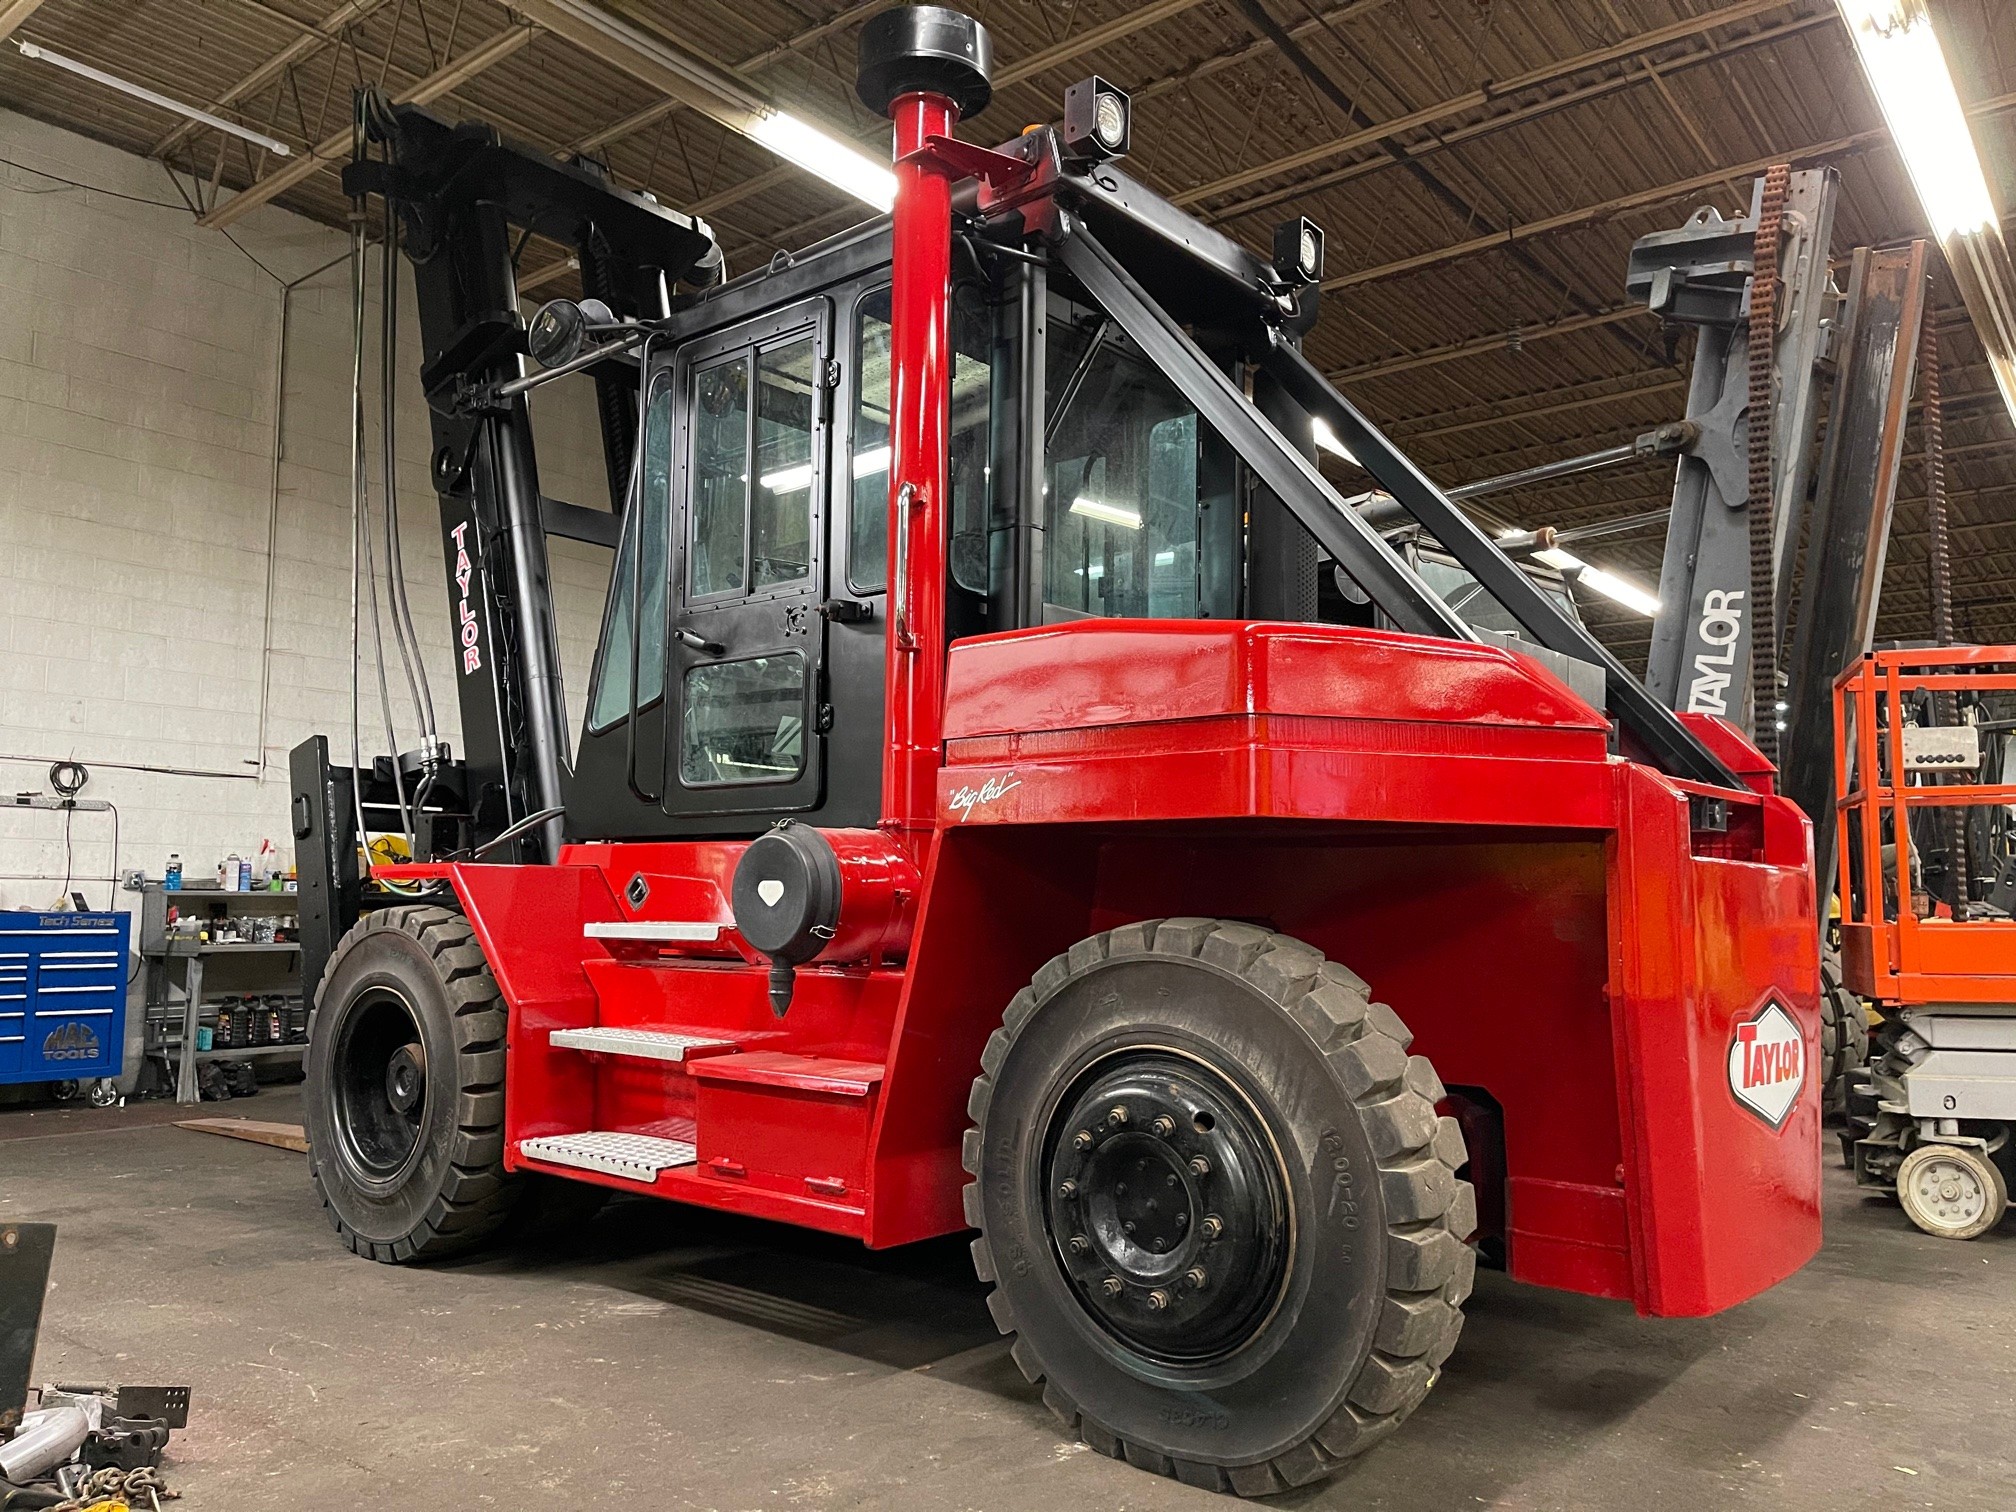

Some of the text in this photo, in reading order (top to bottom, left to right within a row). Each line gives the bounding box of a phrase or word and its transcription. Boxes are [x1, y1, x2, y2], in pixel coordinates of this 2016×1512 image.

[451, 520, 481, 675] TAYLOR
[1687, 589, 1745, 716] TAYLOR
[39, 915, 115, 927] Tech Series
[42, 1048, 100, 1061] TOOLS
[43, 1022, 100, 1050] MAC
[1738, 1024, 1800, 1089] TAYLOR
[1321, 1126, 1361, 1231] 12.00-20
